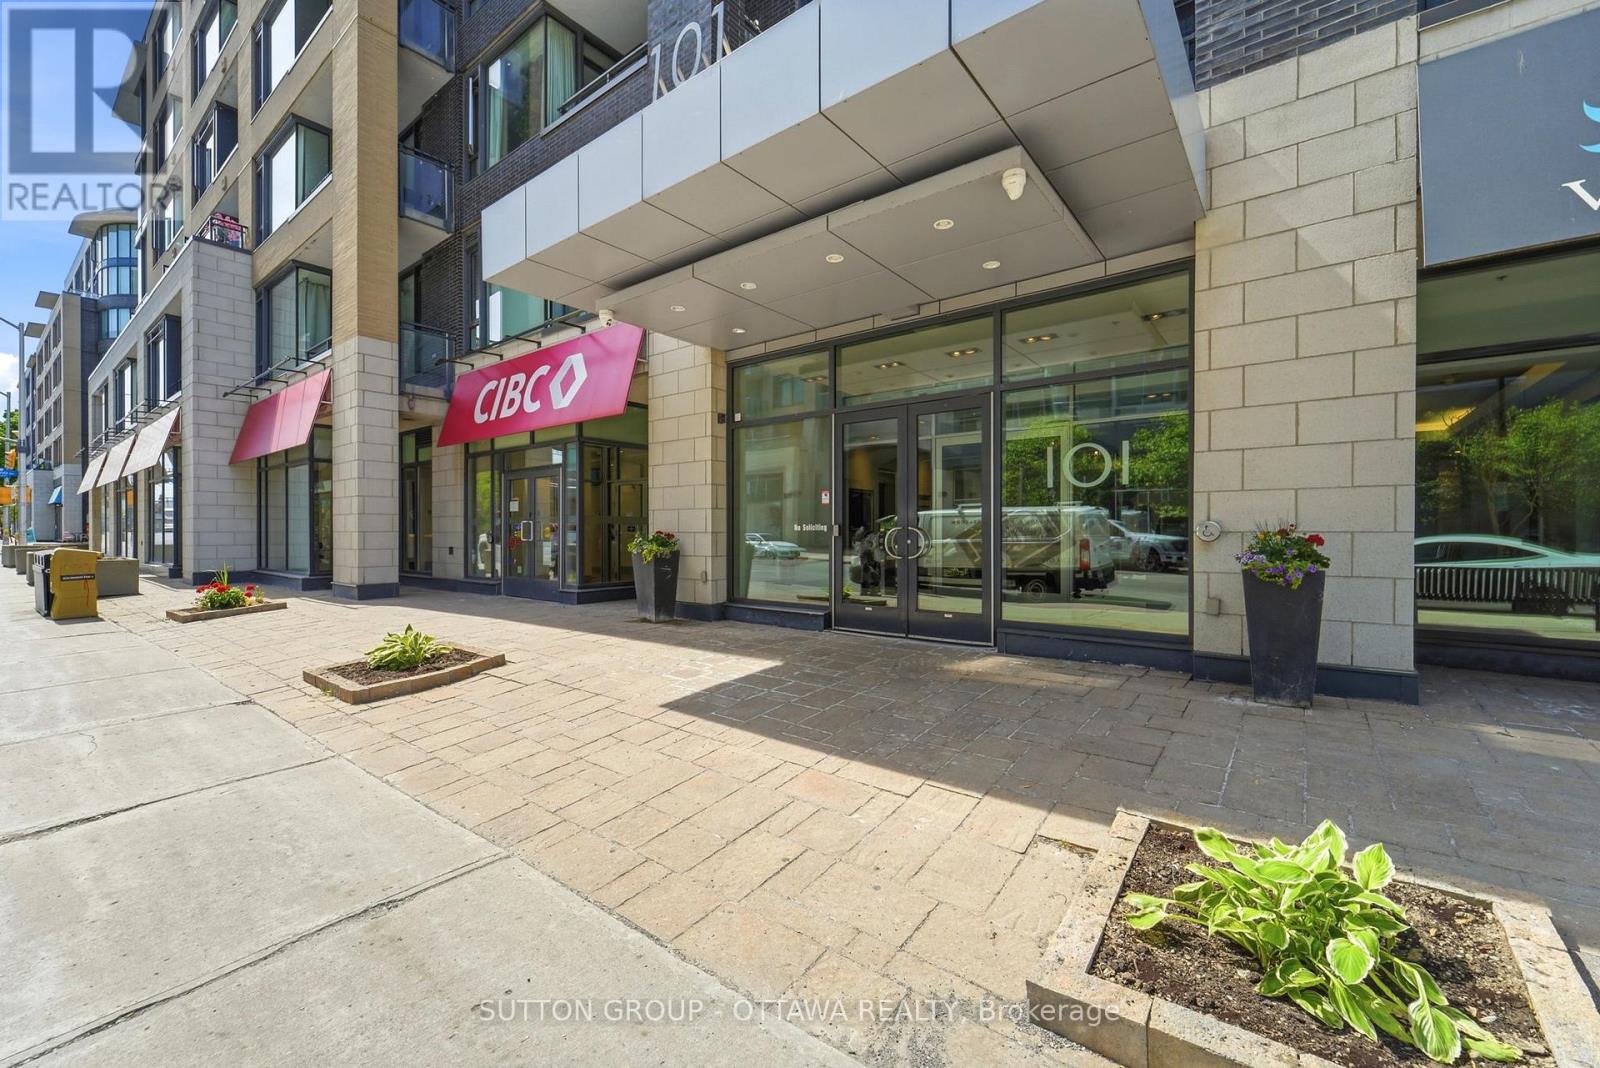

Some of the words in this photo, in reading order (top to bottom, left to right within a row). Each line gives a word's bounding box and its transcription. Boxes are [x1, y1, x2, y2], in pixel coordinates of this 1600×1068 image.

[650, 1, 724, 104] 101
[474, 364, 550, 424] CIBC
[1046, 440, 1130, 488] 101
[802, 523, 828, 533] Soliciting
